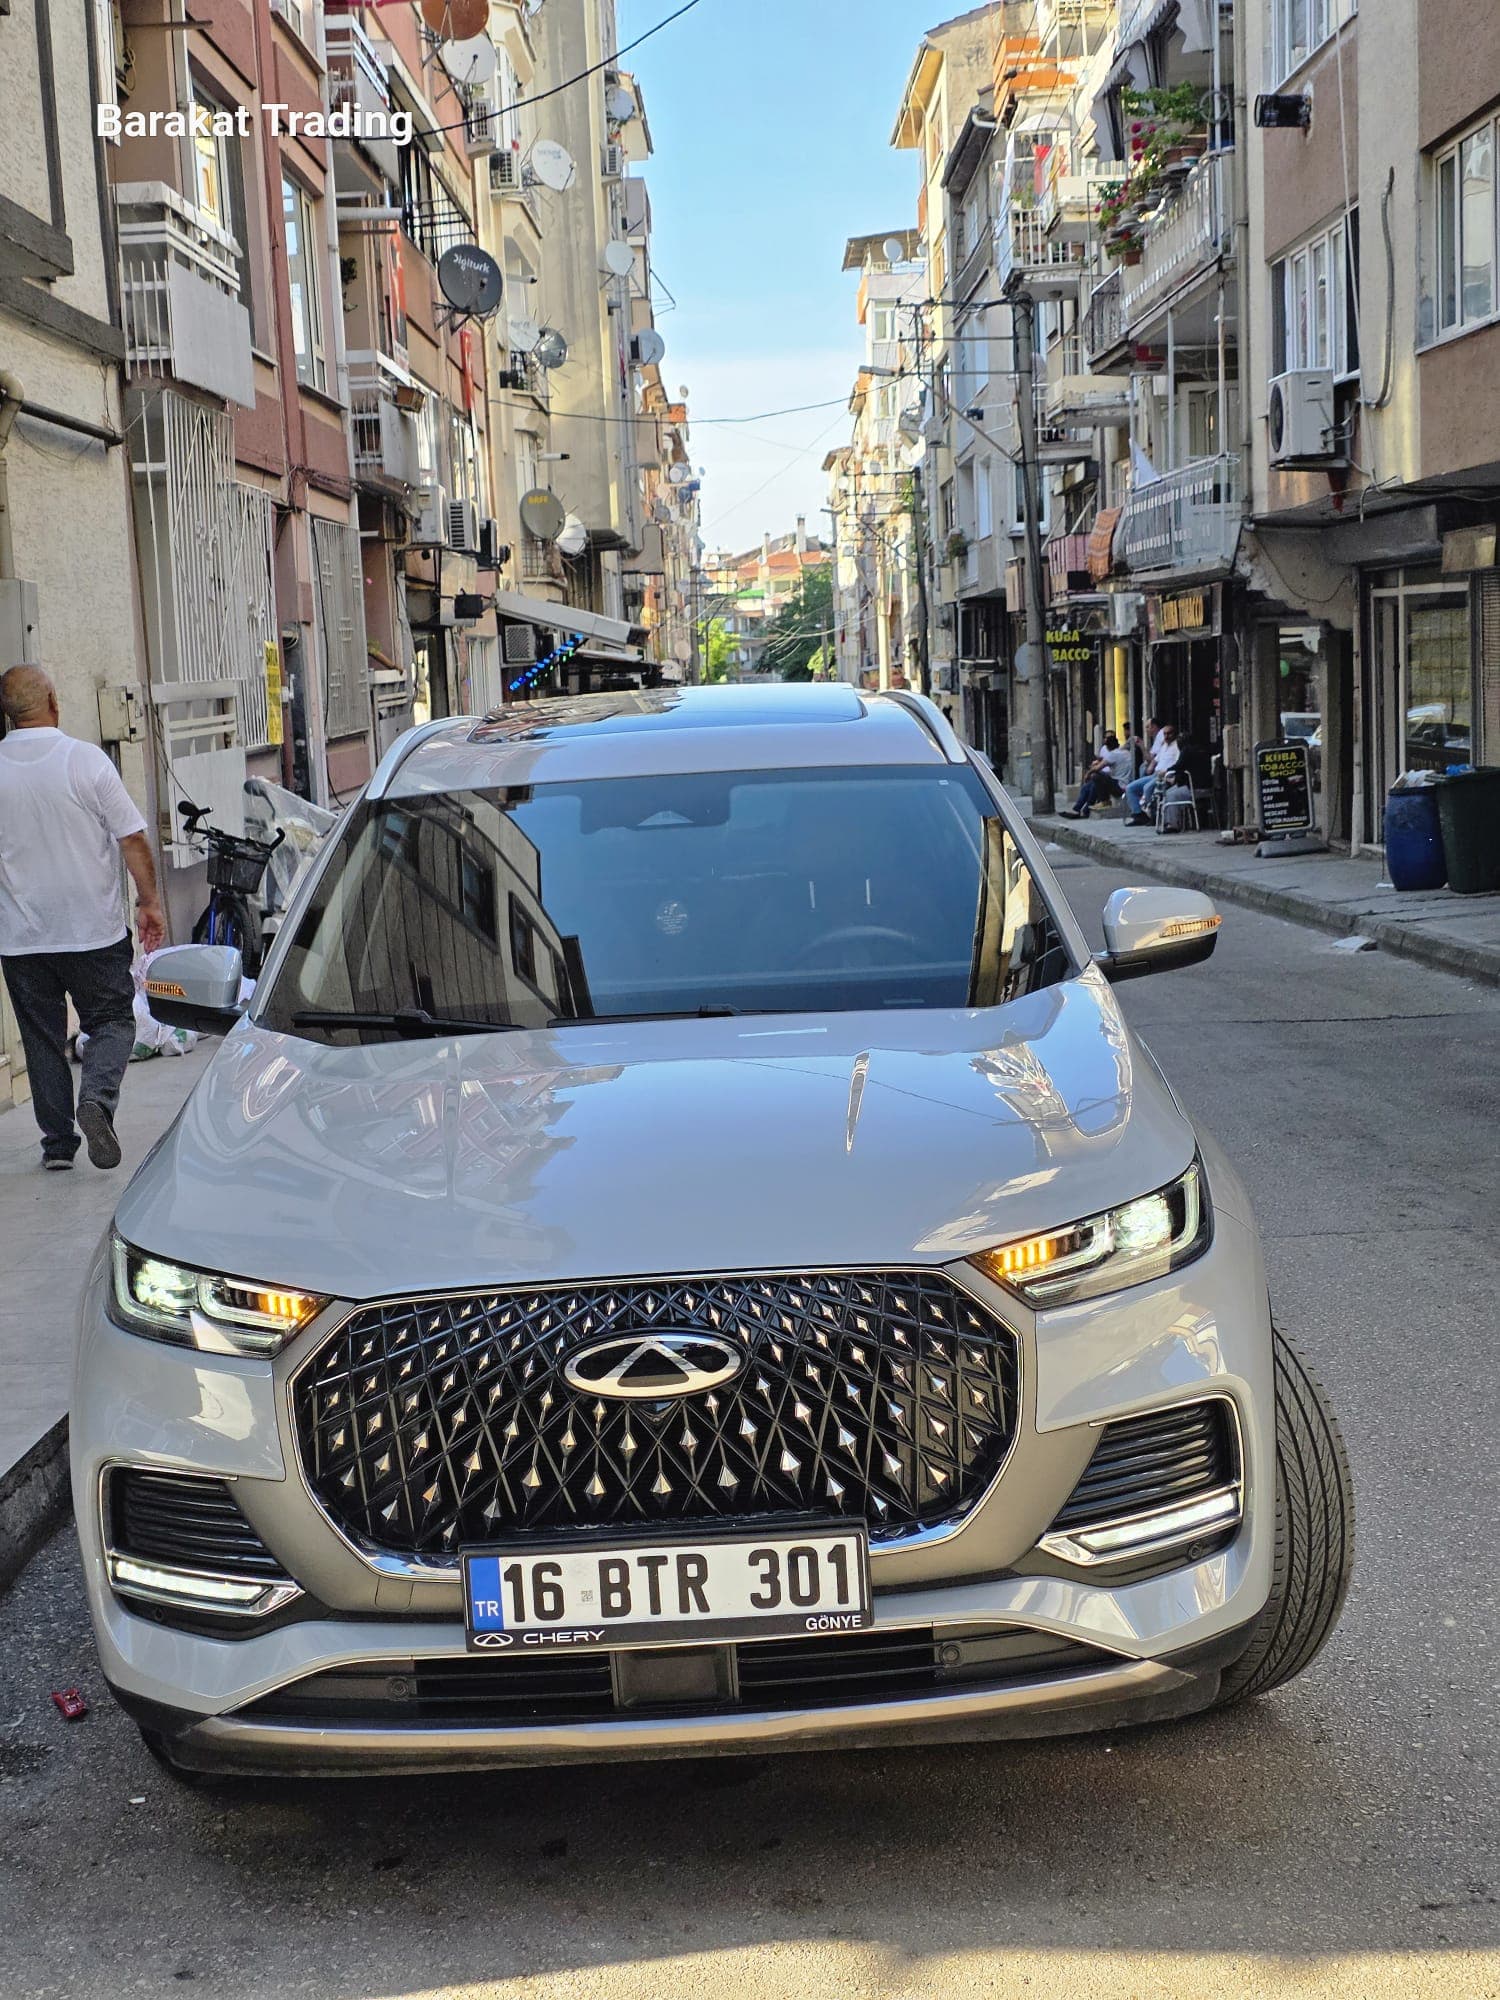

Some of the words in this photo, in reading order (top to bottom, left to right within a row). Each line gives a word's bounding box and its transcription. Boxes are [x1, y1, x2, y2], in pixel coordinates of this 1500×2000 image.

[1052, 648, 1090, 661] BACCO
[1260, 761, 1306, 772] TOBACCO
[503, 1561, 565, 1623] 16
[598, 1553, 710, 1618] BTR
[748, 1543, 851, 1610] 301
[475, 1600, 499, 1617] TR
[805, 1612, 862, 1631] GÖNYE
[523, 1630, 606, 1645] CHERY
